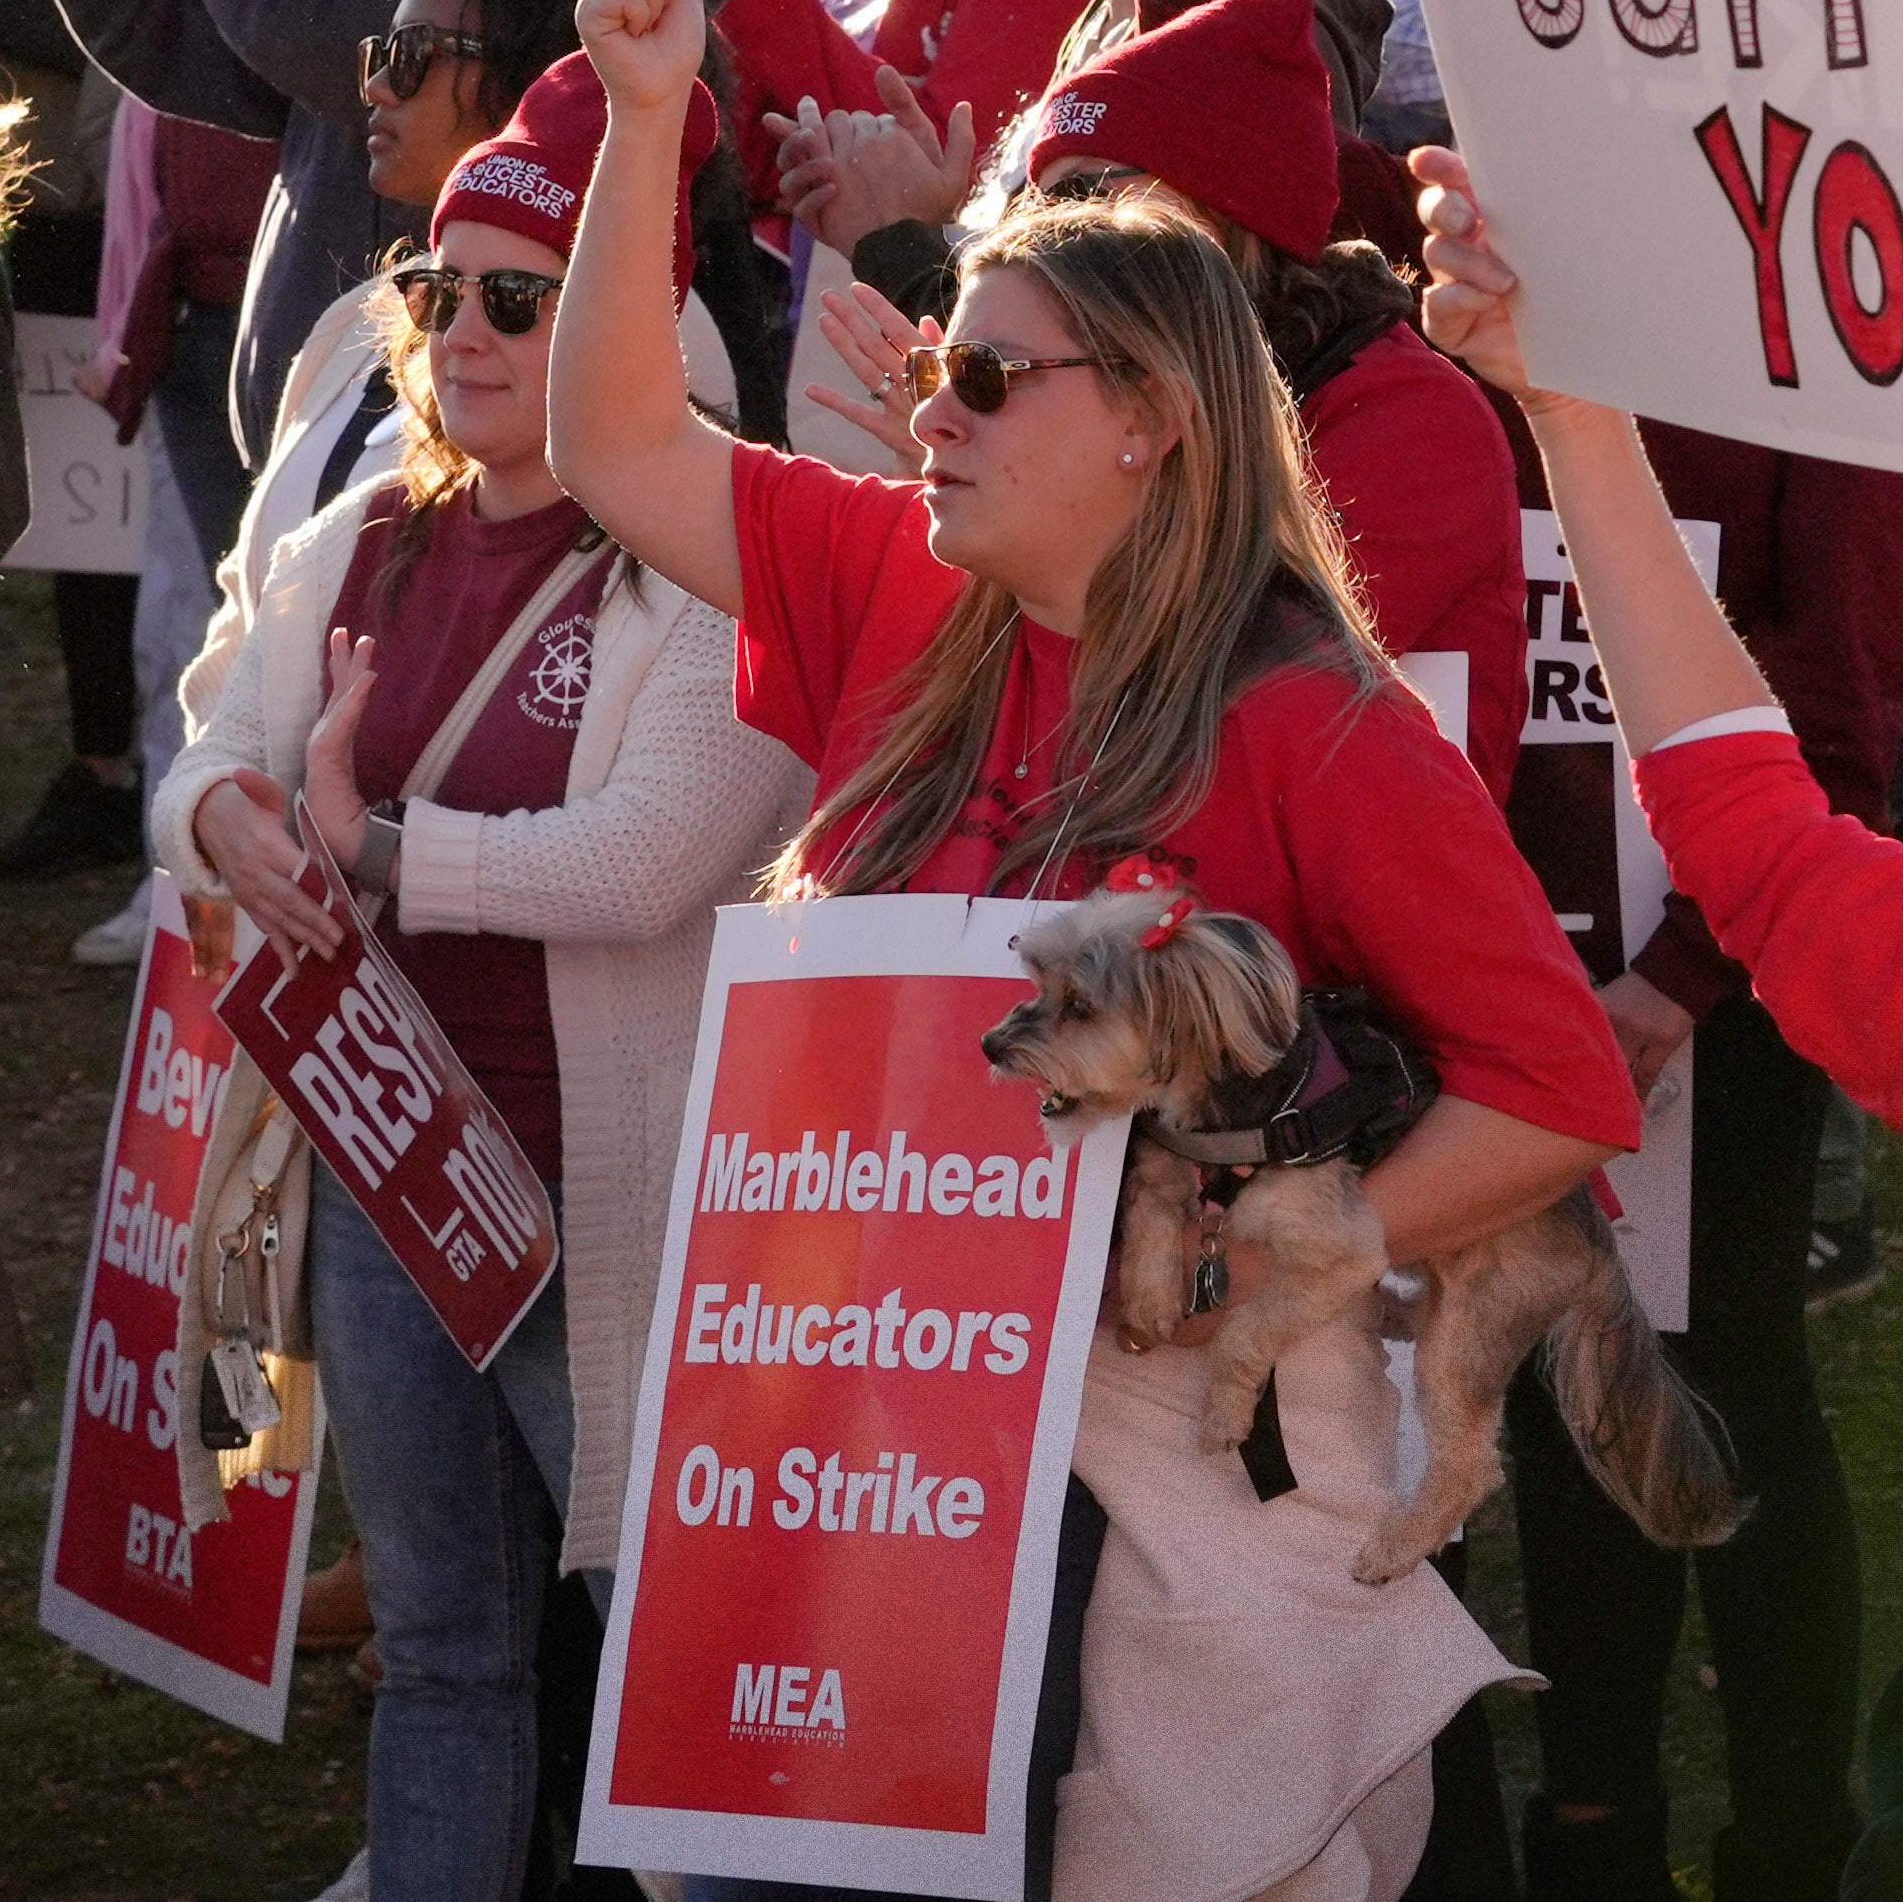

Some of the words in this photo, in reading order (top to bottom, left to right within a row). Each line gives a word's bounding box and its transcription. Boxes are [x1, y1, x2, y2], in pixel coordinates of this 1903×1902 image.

[1064, 91, 1078, 104] OF
[487, 154, 526, 171] UNION
[526, 163, 547, 176] OF
[699, 1130, 1070, 1220] Marblehead
[446, 1229, 487, 1282] GTA
[684, 1282, 1033, 1376] Educators
[84, 1318, 140, 1434] On
[676, 1443, 755, 1527] On
[772, 1446, 986, 1539] Strike
[126, 1503, 193, 1589] BTA
[729, 1724, 788, 1738] MARBLEHEAD
[791, 1727, 846, 1741] EDUCATION
[730, 1662, 846, 1730] MEA
